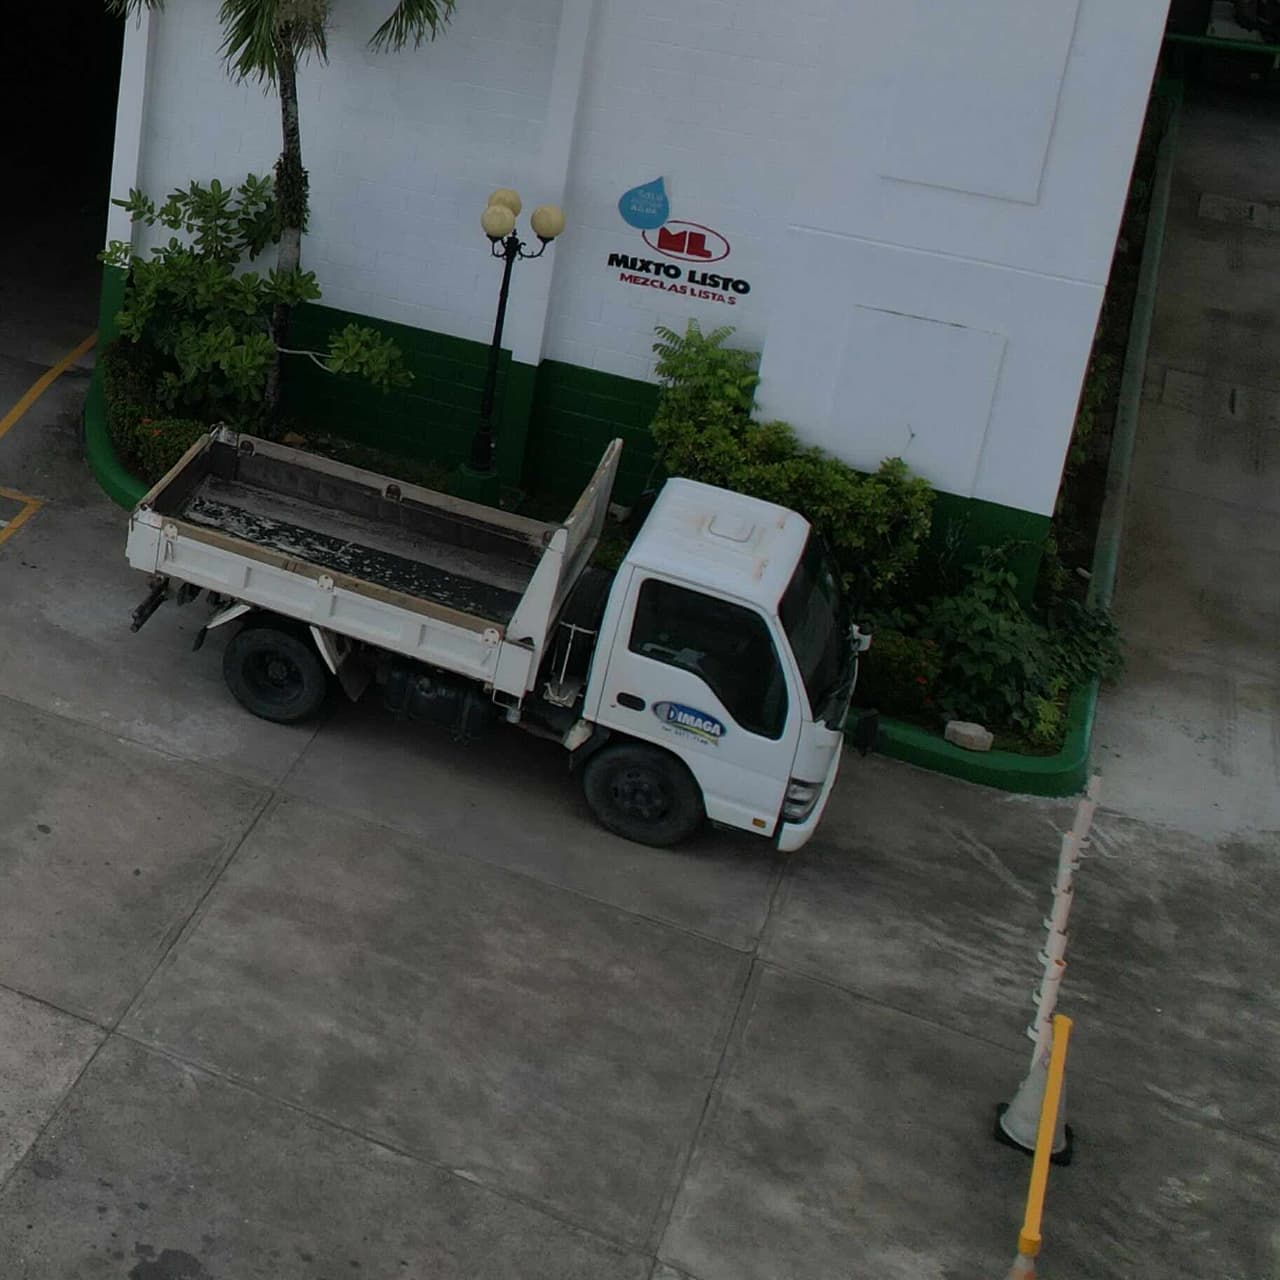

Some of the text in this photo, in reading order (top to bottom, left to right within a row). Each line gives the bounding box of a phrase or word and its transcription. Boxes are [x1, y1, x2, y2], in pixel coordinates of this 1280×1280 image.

[608, 253, 751, 295] MIXTO LISTO
[619, 272, 737, 306] MEZCLAS LISTAS
[667, 704, 721, 737] DIMAGA
